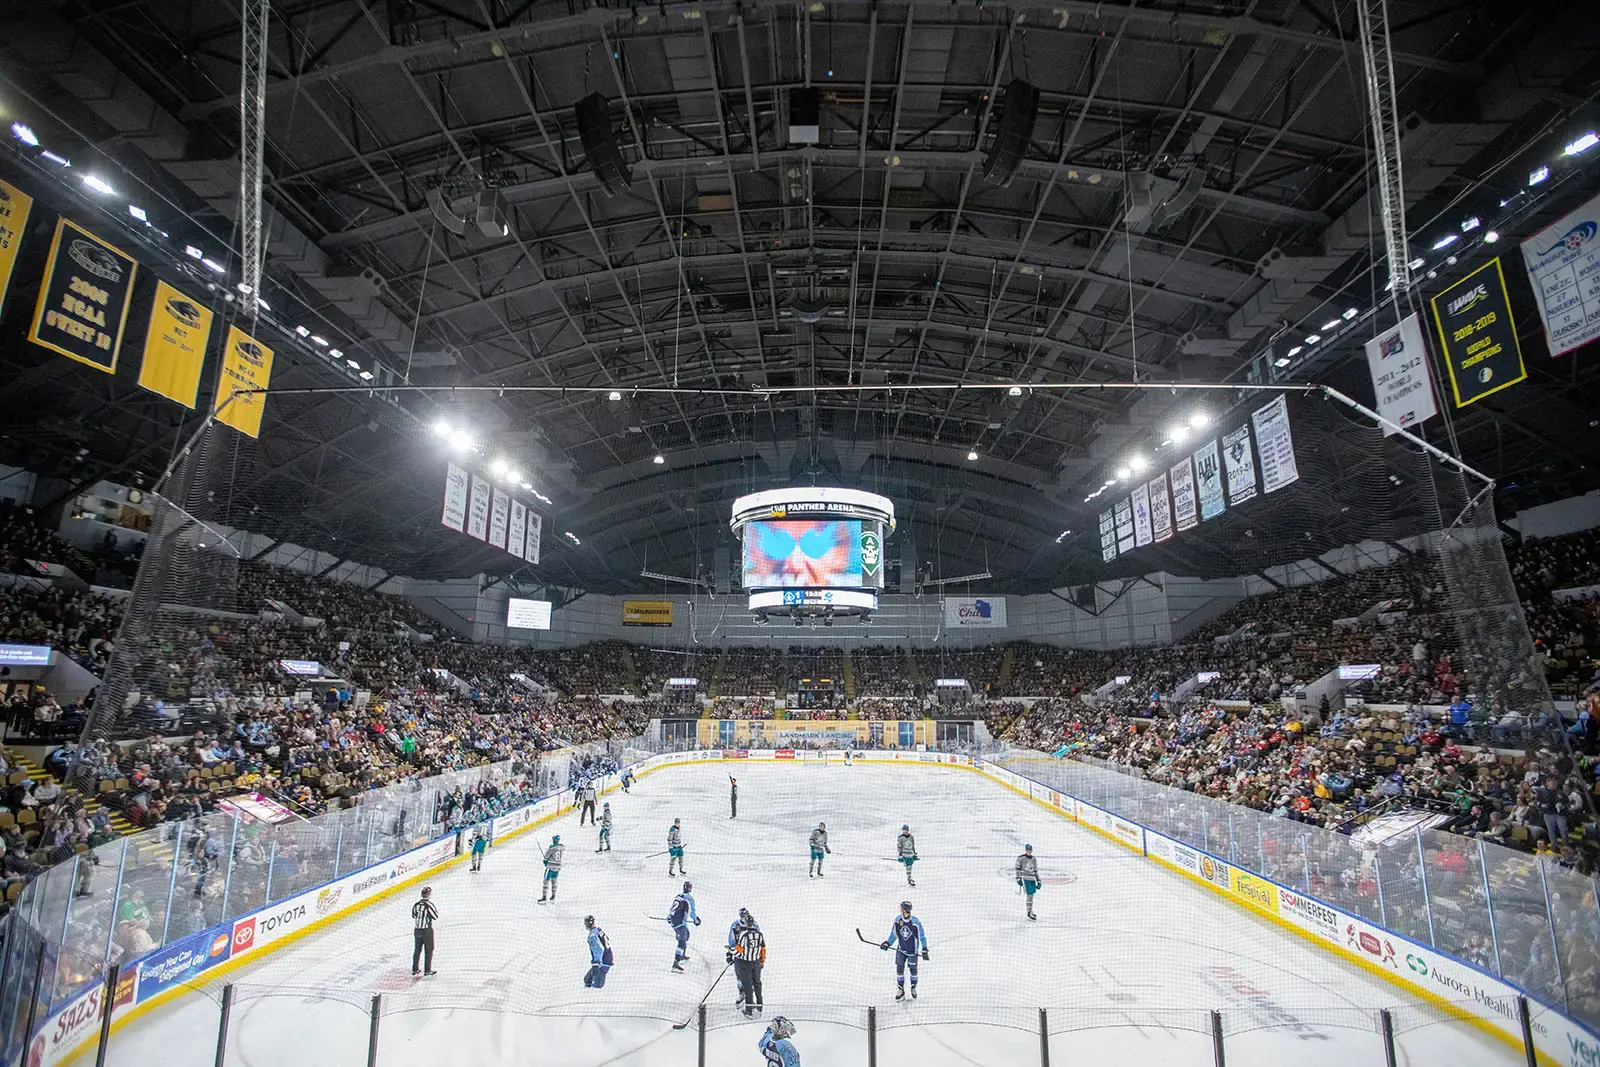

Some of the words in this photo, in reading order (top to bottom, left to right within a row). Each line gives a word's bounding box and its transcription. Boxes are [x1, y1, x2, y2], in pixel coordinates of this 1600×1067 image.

[62, 293, 106, 327] NCAA
[1556, 292, 1566, 303] 27
[46, 310, 95, 342] SWEET
[1453, 311, 1497, 342] 2018-2019
[1563, 315, 1570, 323] 17
[1462, 343, 1502, 369] CHAMPIONS
[1466, 336, 1491, 355] WORLD
[1198, 453, 1218, 479] AHL
[788, 503, 826, 511] PANTHER
[827, 503, 854, 512] ARENA
[260, 905, 306, 934] TOYOTA
[1280, 890, 1337, 926] SUMMERFEST
[141, 963, 165, 981] Energy
[165, 956, 178, 969] You
[178, 950, 192, 961] Can
[159, 959, 192, 983] Depend
[192, 954, 205, 967] On
[1431, 967, 1470, 996] Aurora
[1474, 985, 1513, 1019] Health
